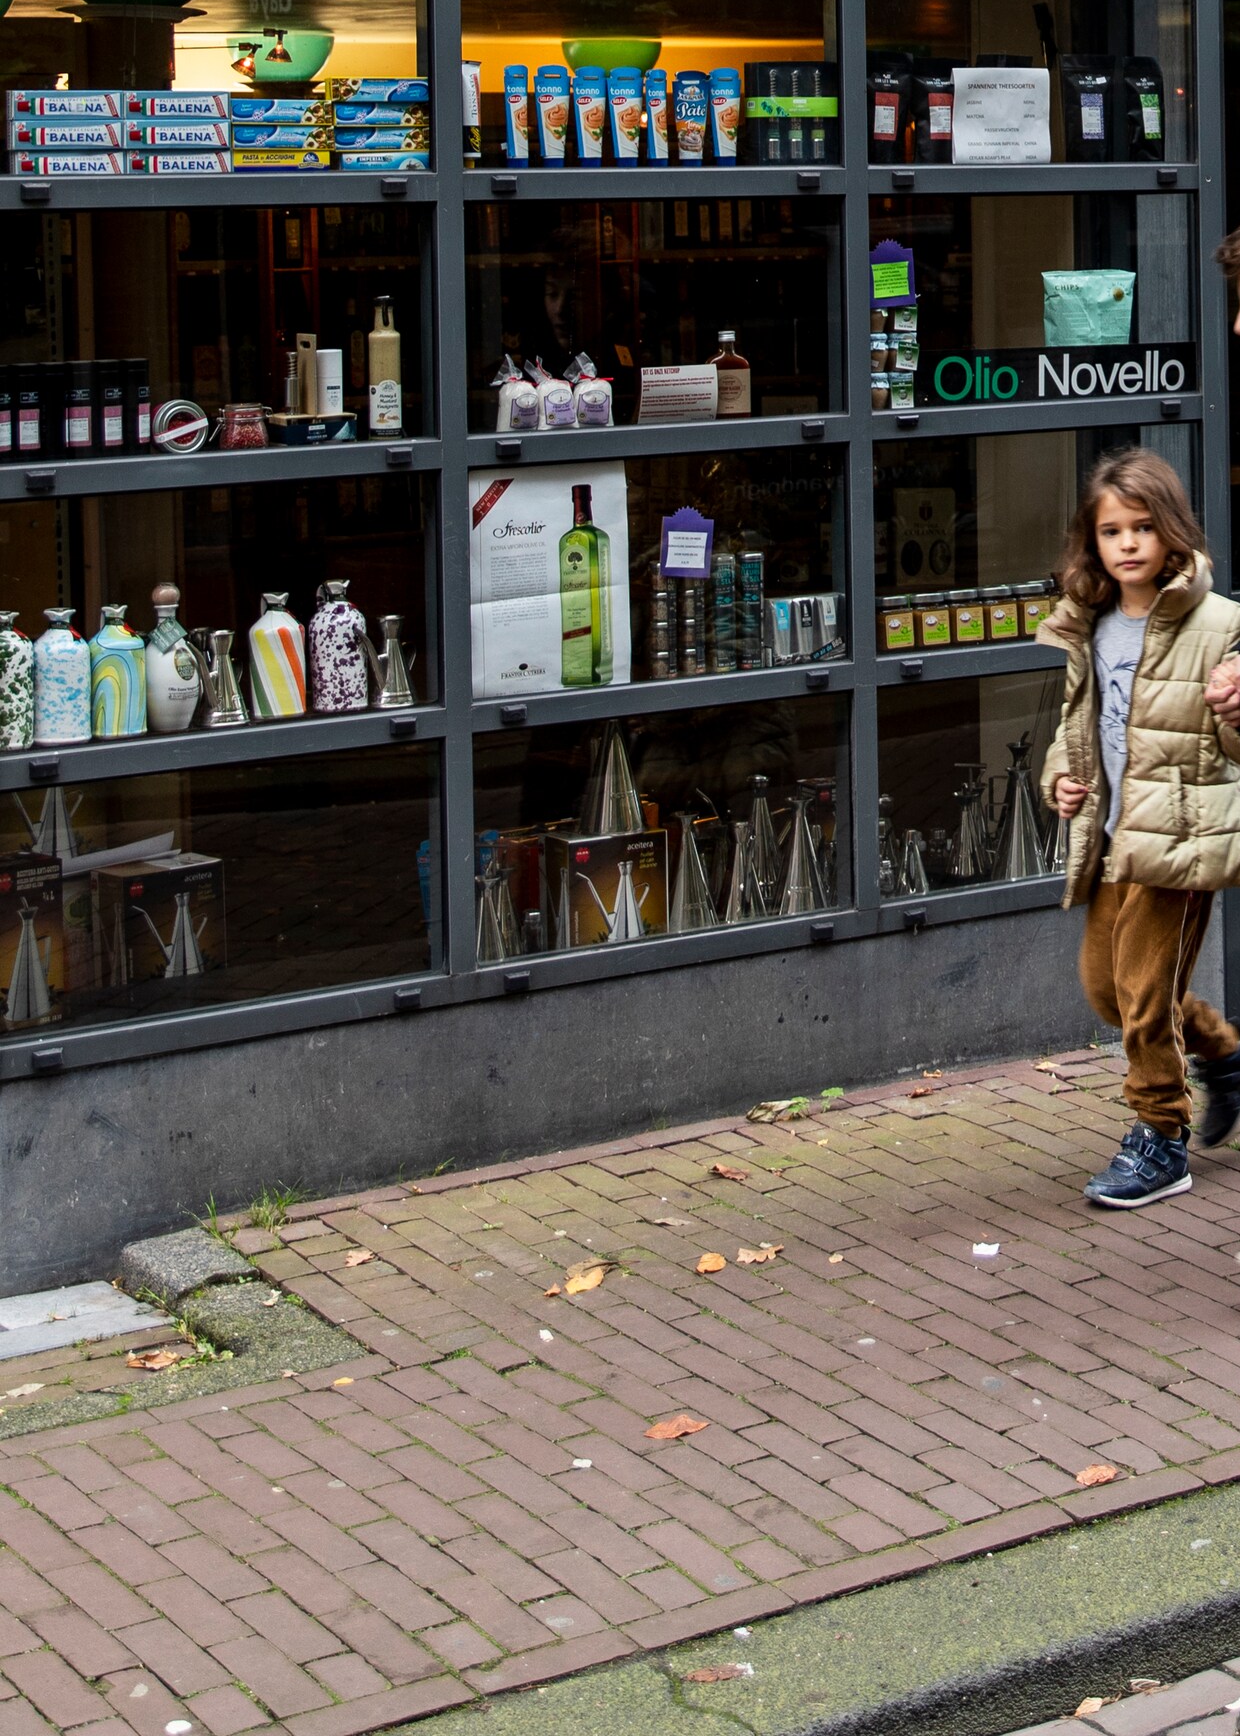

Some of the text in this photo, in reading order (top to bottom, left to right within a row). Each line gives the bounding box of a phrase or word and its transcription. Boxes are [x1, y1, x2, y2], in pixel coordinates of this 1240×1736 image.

[537, 85, 562, 93] tonno
[575, 86, 600, 95] tonno
[610, 87, 635, 96] tonno
[711, 88, 734, 96] tonno
[676, 102, 706, 120] Pâté
[934, 350, 1186, 402] Olio Novello
[493, 519, 547, 539] Frescolio
[627, 841, 654, 850] aceitera
[184, 871, 212, 882] aceitera
